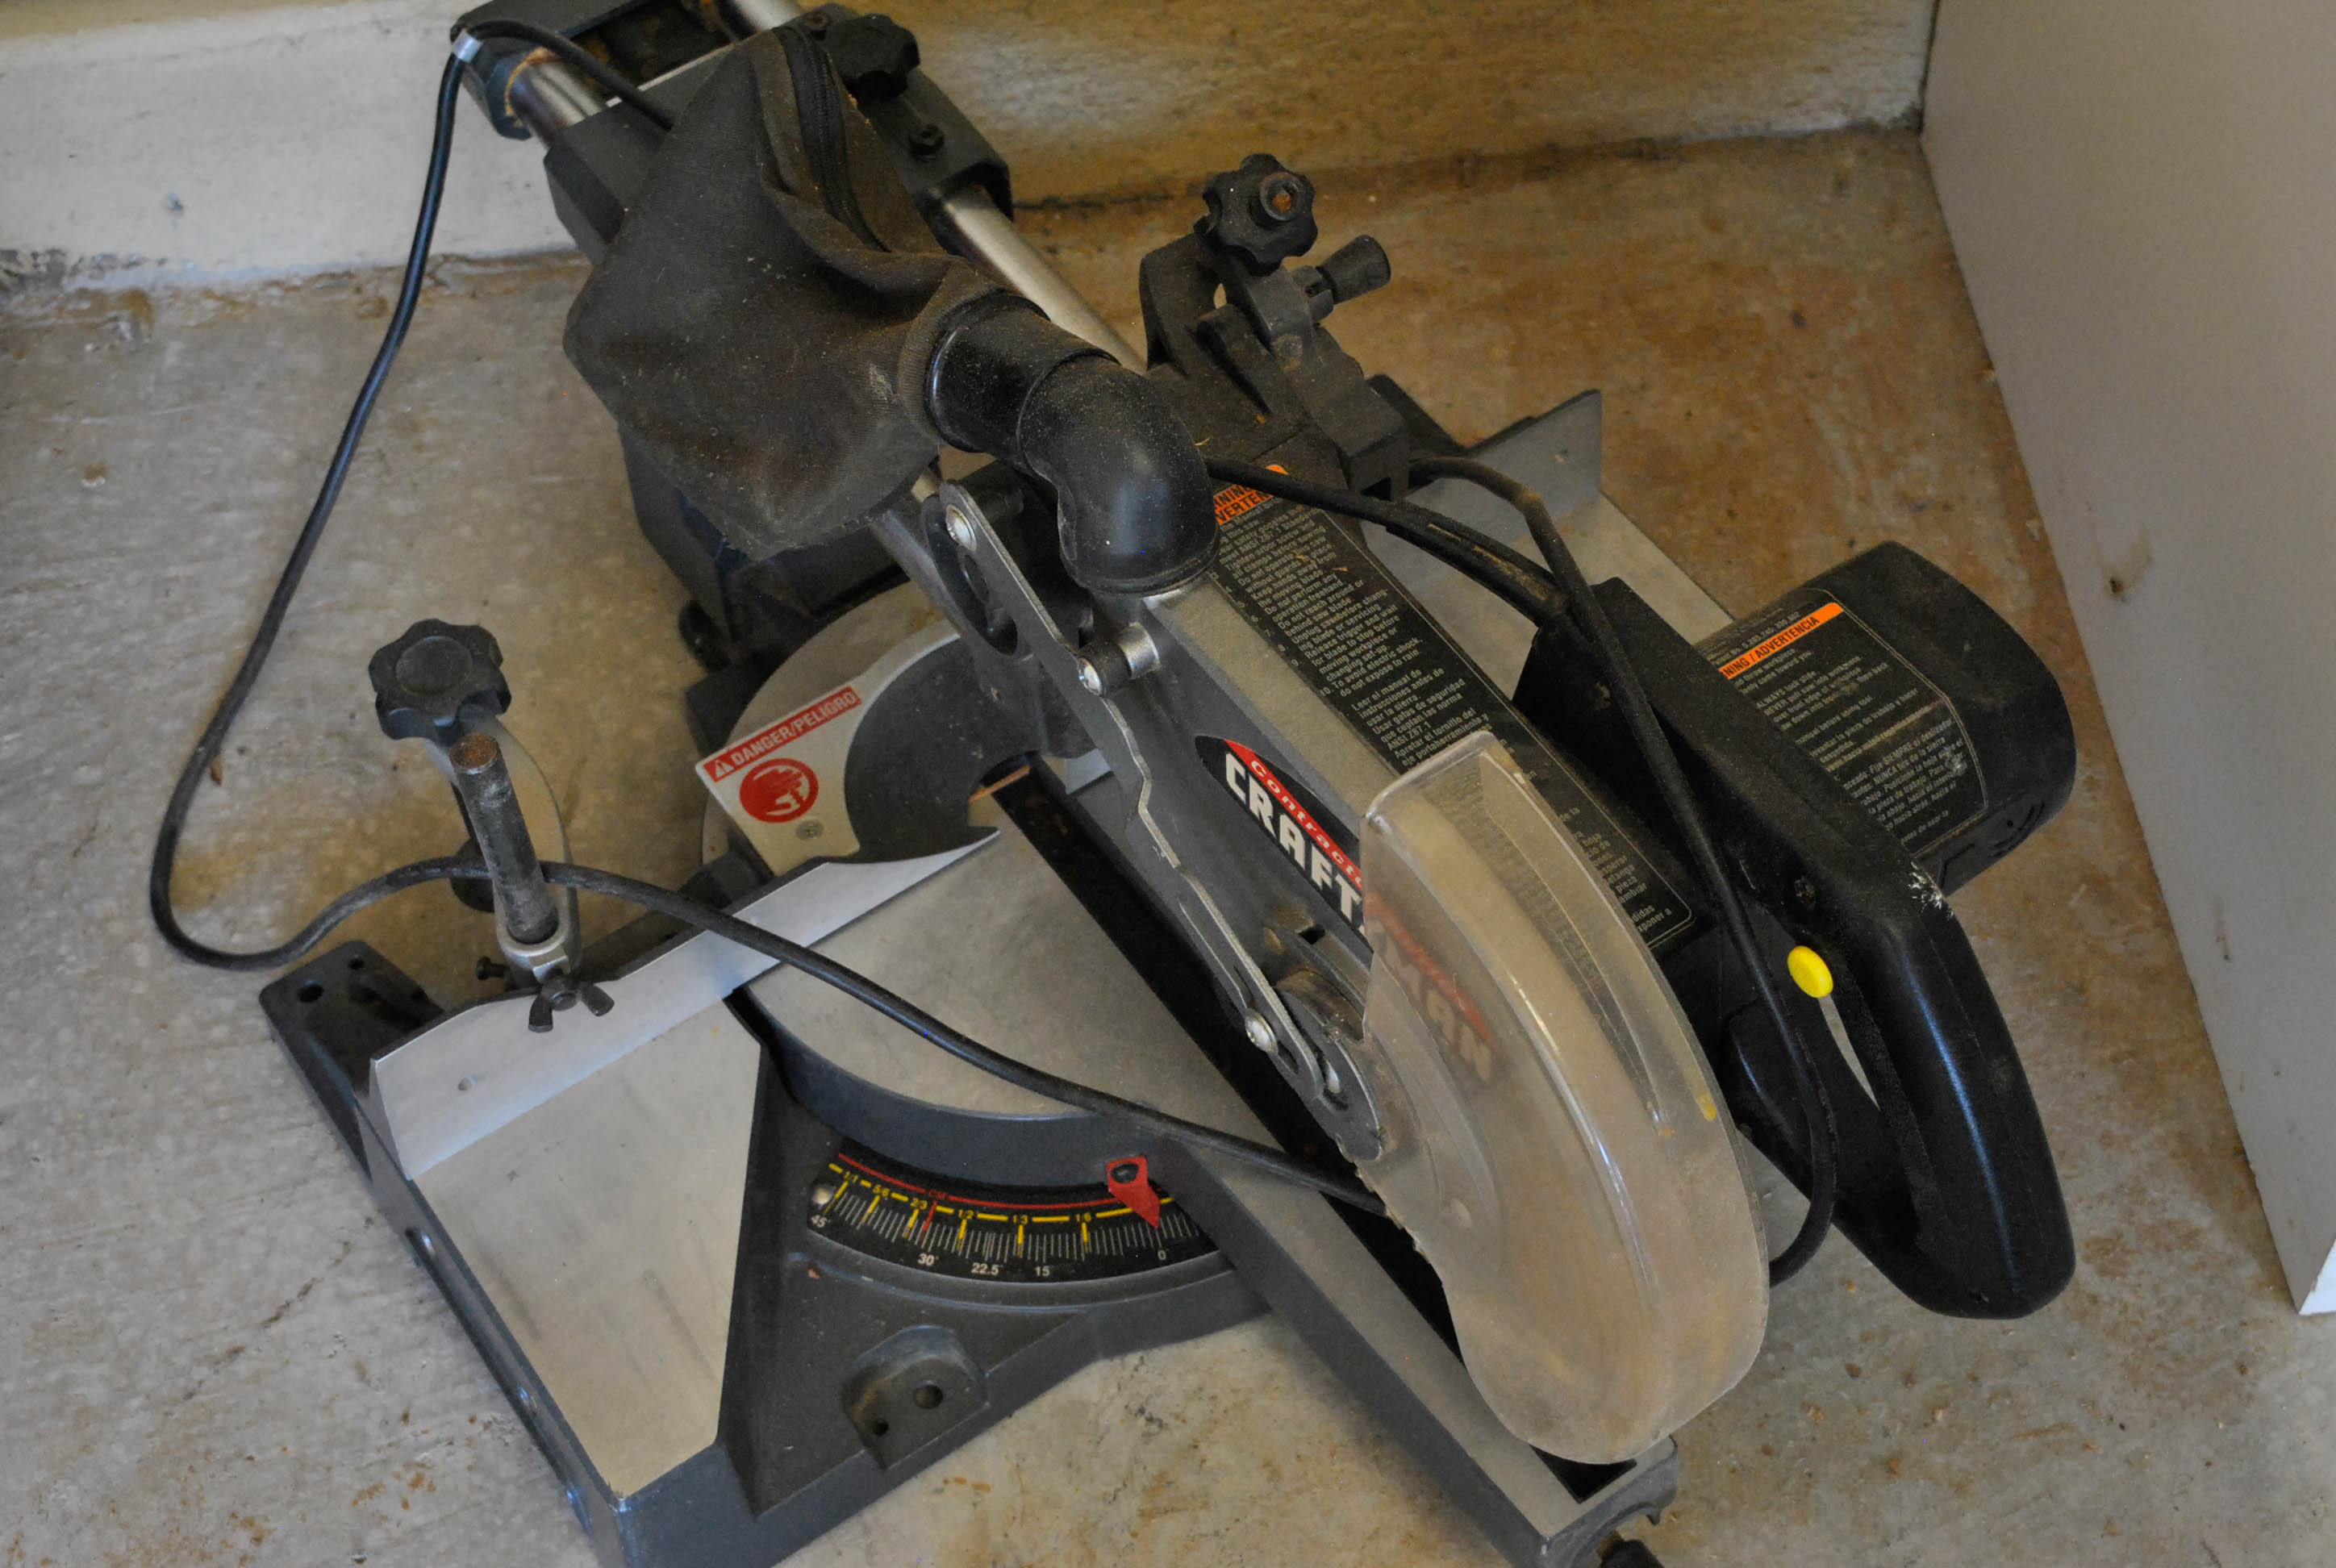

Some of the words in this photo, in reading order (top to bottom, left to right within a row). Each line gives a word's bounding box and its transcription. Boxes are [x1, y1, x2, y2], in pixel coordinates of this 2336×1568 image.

[1265, 606, 1277, 614] Do
[1277, 598, 1291, 607] not
[1291, 582, 1323, 601] perform
[1322, 573, 1338, 584] any
[1271, 599, 1309, 622] operation
[1279, 619, 1291, 628] Do
[1291, 612, 1304, 621] not
[1304, 600, 1327, 614] reach
[1326, 585, 1354, 602] around
[1285, 619, 1312, 636] behind
[1313, 611, 1329, 620] saw
[1291, 626, 1320, 644] Unplug
[1305, 638, 1337, 658] Release
[1337, 623, 1365, 641] trigger
[1364, 615, 1380, 625] and
[1312, 628, 1335, 643] blade
[1312, 657, 1324, 665] for
[1324, 644, 1347, 658] blade
[1356, 630, 1374, 641] stop
[1374, 615, 1400, 631] before
[1754, 615, 1819, 657] ADVERTENCIA
[1319, 656, 1349, 673] moving
[1348, 633, 1389, 657] workpiece
[1324, 659, 1362, 682] changing
[1333, 679, 1345, 687] To
[1344, 667, 1366, 682] avoid
[1366, 651, 1396, 669] electric
[1339, 687, 1351, 696] do
[1350, 679, 1366, 690] not
[1364, 664, 1394, 682] expose
[1351, 697, 1371, 710] Leer
[1380, 676, 1410, 694] manual
[1410, 669, 1422, 677] de
[1358, 687, 1412, 718] instrucciones
[1433, 668, 1444, 676] de
[731, 691, 856, 765] DANGER/PELIGRO
[1366, 714, 1385, 726] usar
[1372, 720, 1393, 734] Usar
[1415, 701, 1426, 709] de
[1379, 731, 1397, 743] que
[1423, 707, 1437, 716] las
[1394, 738, 1425, 757] Apretar
[1423, 732, 1433, 740] el
[1432, 716, 1462, 735] tornillo
[1461, 707, 1476, 718] del
[1385, 735, 1408, 749] ANSI
[1616, 883, 1649, 903] ambiar
[1635, 913, 1667, 933] xponer
